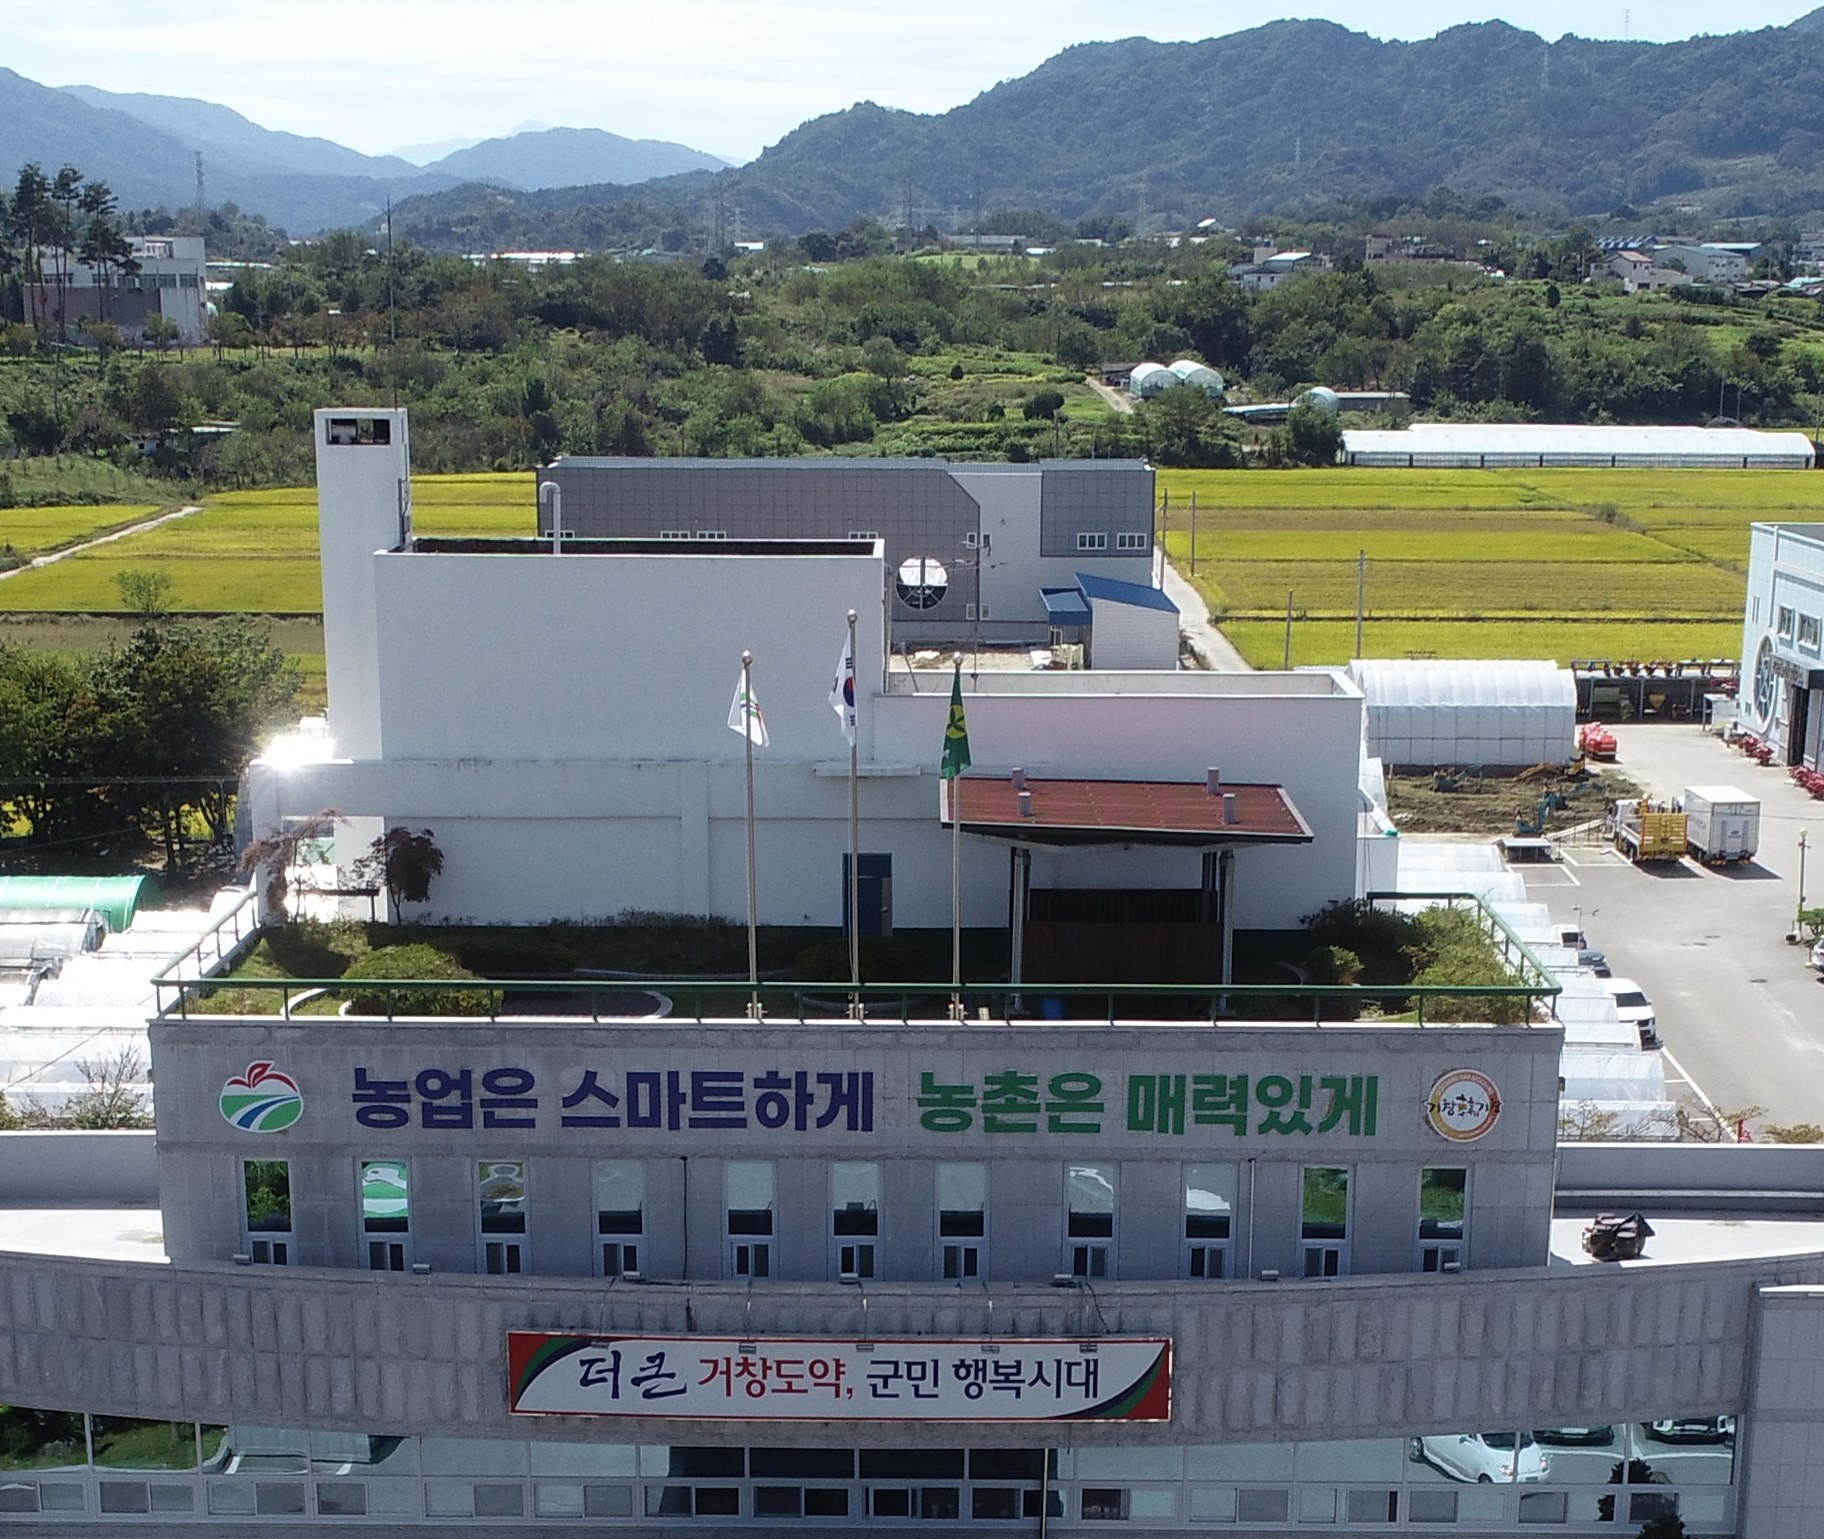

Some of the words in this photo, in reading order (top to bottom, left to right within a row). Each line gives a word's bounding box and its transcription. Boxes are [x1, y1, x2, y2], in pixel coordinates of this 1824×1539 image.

[352, 1067, 538, 1130] 농업은
[561, 1069, 874, 1133] 스마트하게
[917, 1070, 1105, 1134] 농촌은
[1126, 1074, 1379, 1137] 매력있게
[578, 1350, 621, 1400] 더
[630, 1350, 688, 1399] 큰
[697, 1357, 854, 1401] 거창도약,
[866, 1358, 939, 1400] 군민
[952, 1358, 1099, 1400] 행복시대
